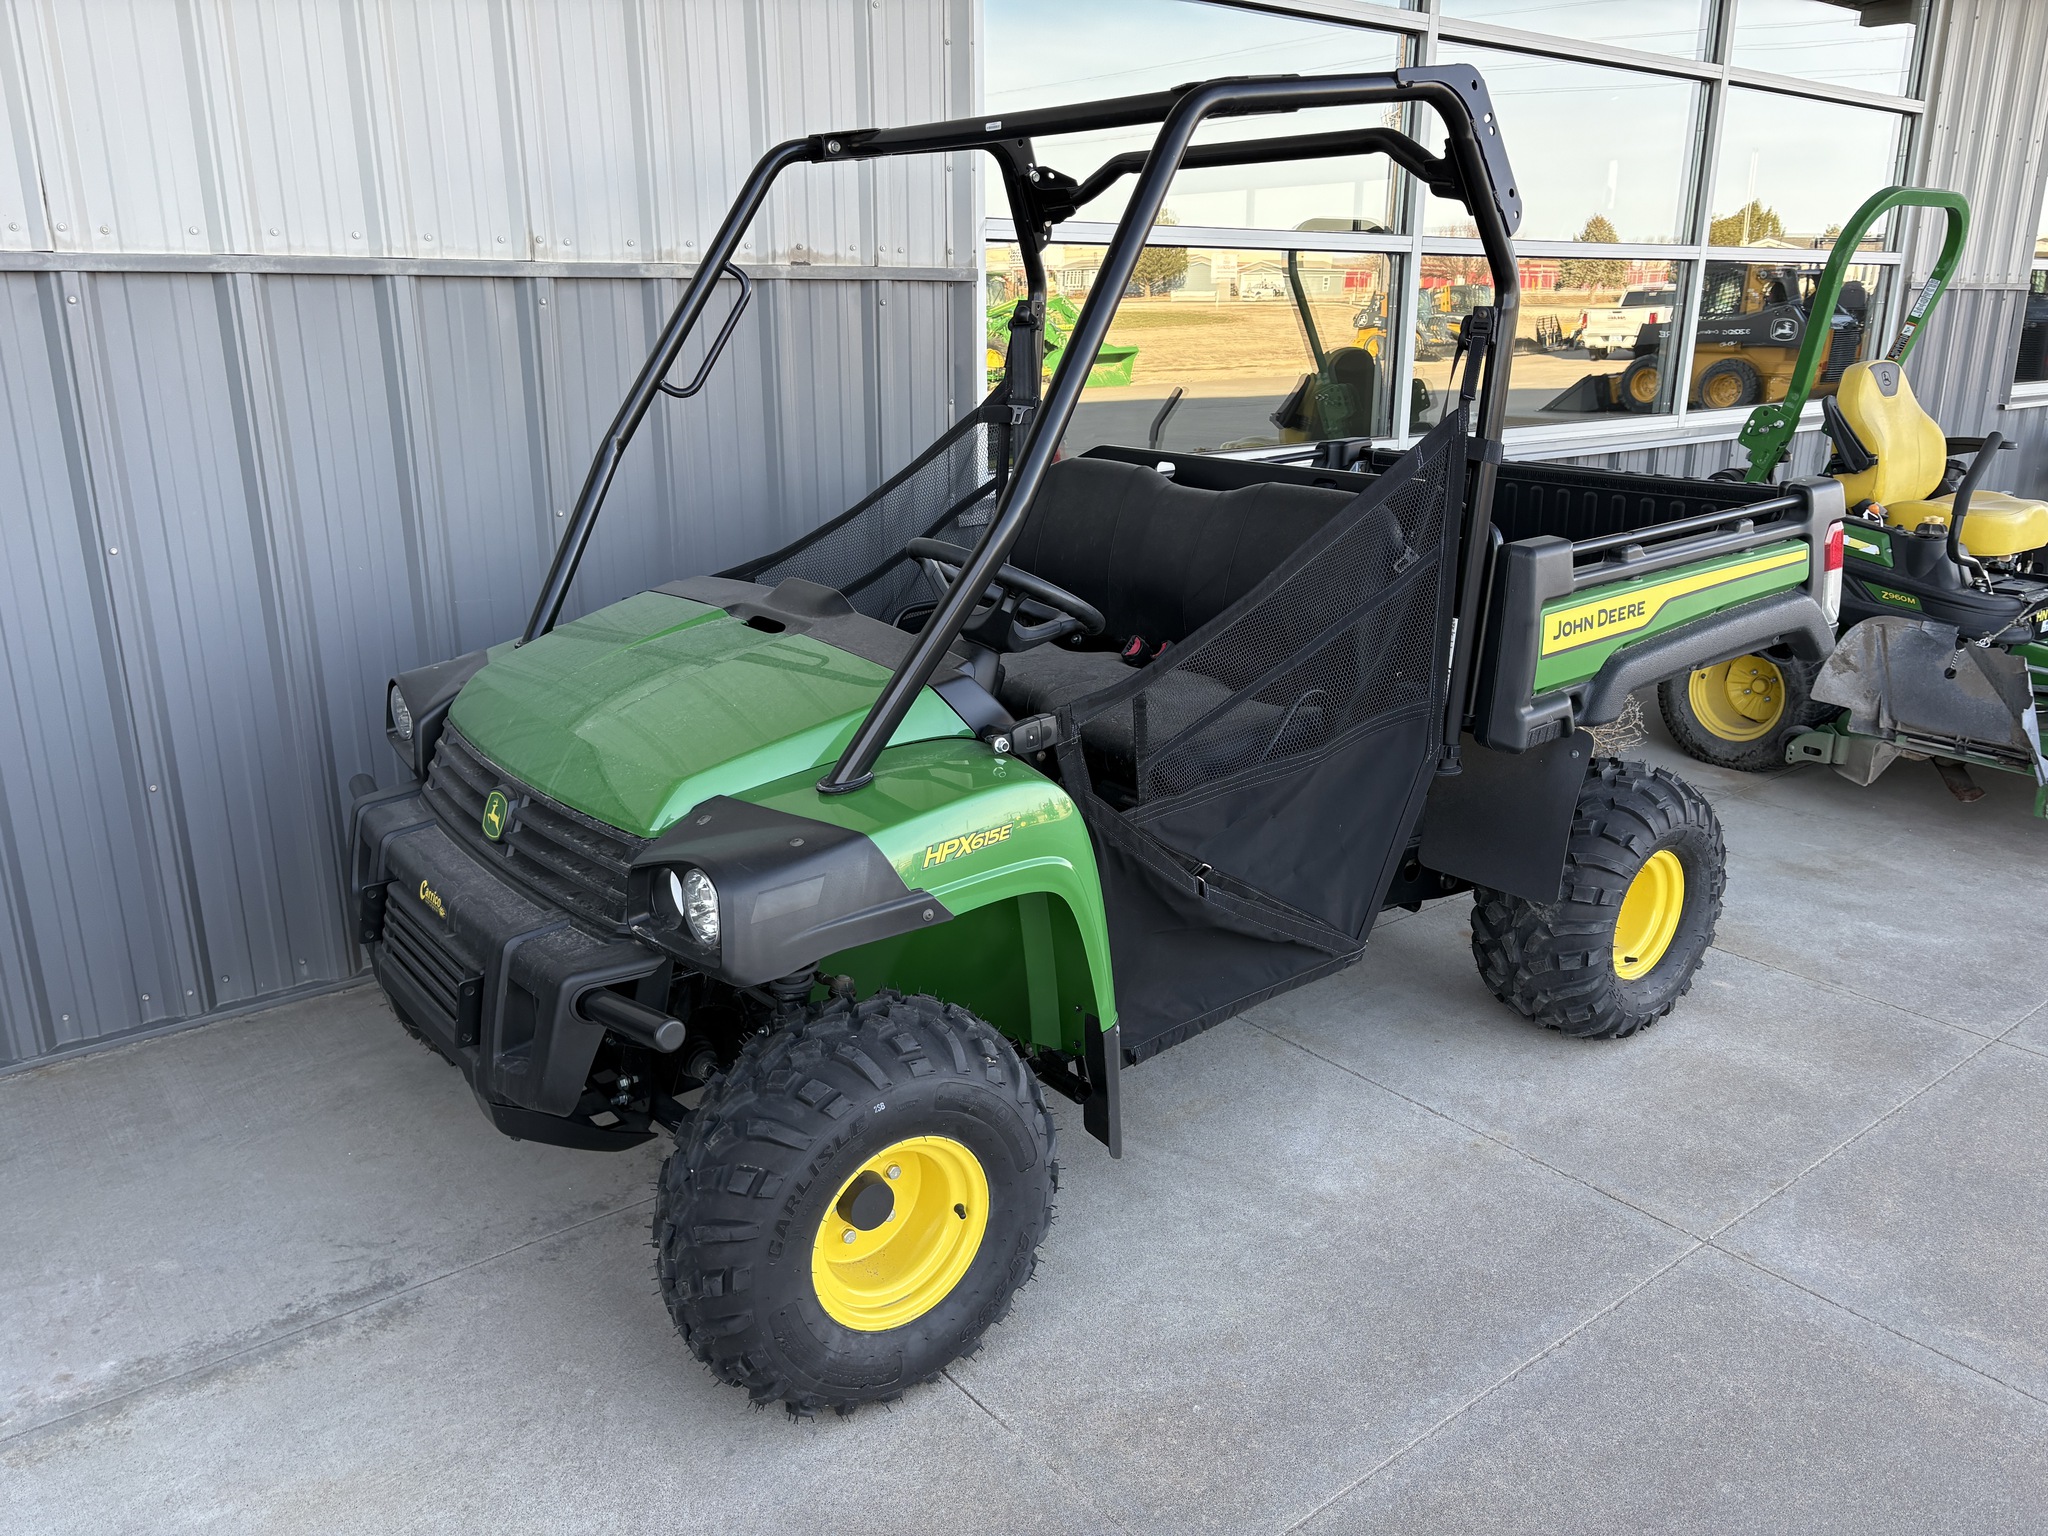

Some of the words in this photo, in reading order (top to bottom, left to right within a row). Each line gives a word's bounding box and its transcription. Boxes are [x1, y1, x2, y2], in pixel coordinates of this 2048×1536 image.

[1881, 590, 1916, 604] Z960M
[1553, 614, 1594, 640] JOHN
[1597, 601, 1645, 627] DEERE
[922, 822, 1014, 869] HPX615E
[767, 1114, 870, 1263] CARLISLE
